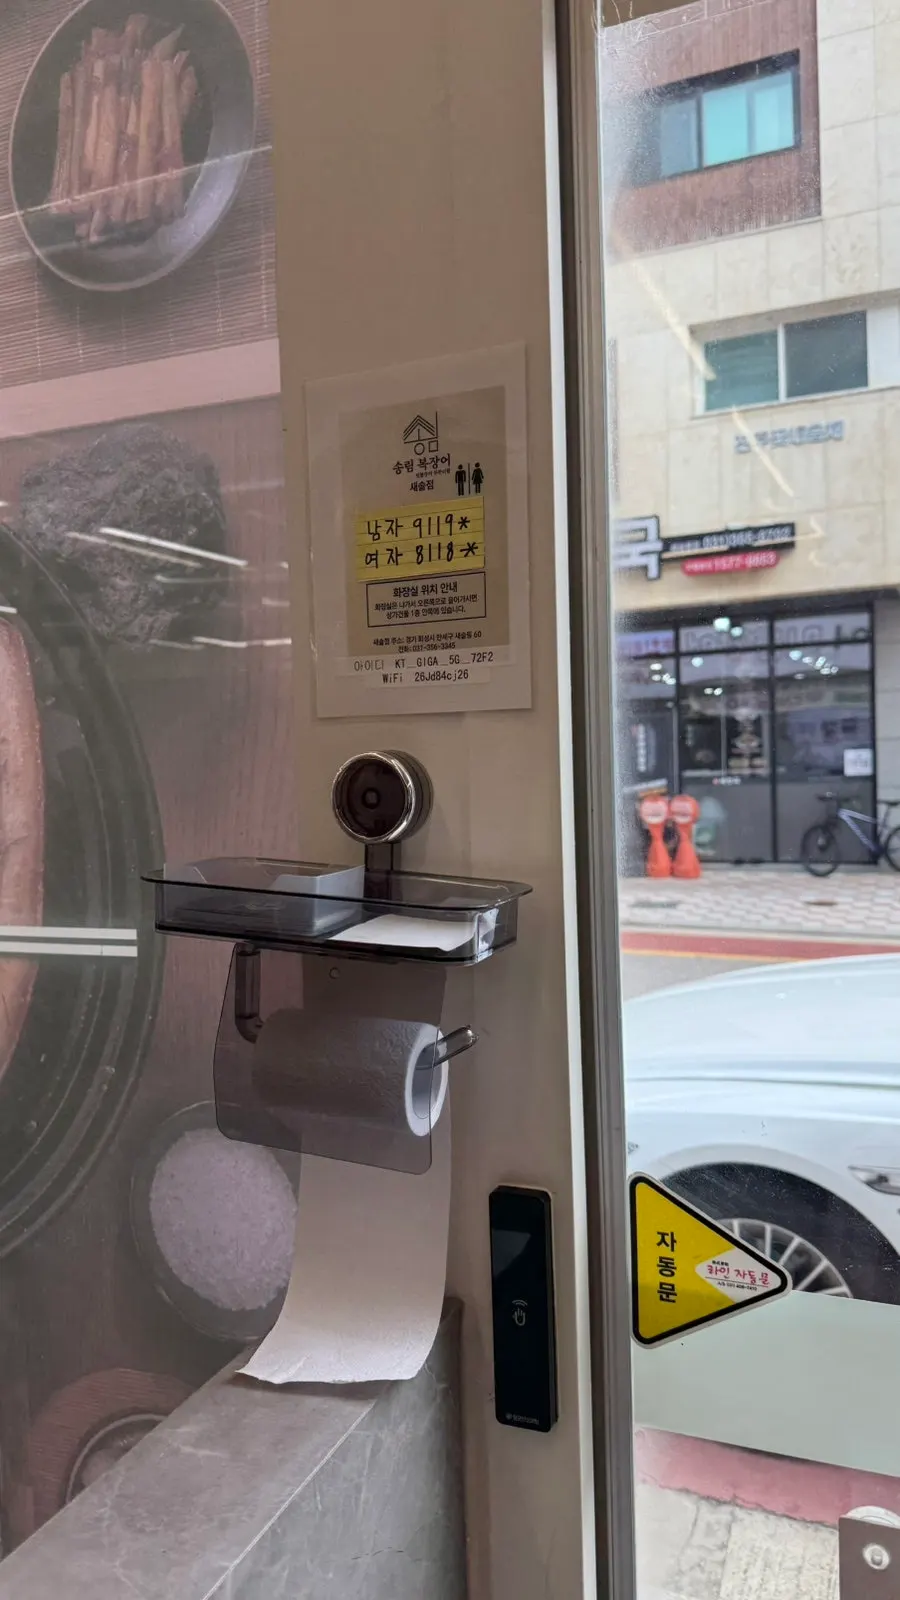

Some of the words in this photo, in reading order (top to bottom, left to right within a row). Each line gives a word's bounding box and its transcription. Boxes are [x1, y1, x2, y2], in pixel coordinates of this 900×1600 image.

[392, 459, 414, 475] 송림
[417, 453, 451, 471] 복장어
[409, 479, 434, 492] 새솔점
[367, 518, 403, 542] 남자
[365, 546, 403, 569] 여자
[392, 586, 419, 598] 화장실
[420, 583, 438, 595] 위치
[440, 581, 458, 594] 안내
[374, 602, 399, 612] 화장실은
[417, 597, 447, 607] 오른쪽으로
[447, 594, 478, 605] 들어가시면
[386, 610, 409, 620] 상가건물
[411, 609, 420, 618] 1층
[422, 607, 440, 617] 안쪽에
[440, 604, 466, 615] 있습니다.
[406, 635, 417, 644] 경기
[418, 633, 435, 643] 화성시
[473, 630, 482, 638] 60
[353, 659, 385, 672] 아이디
[382, 672, 403, 684] WiFi
[706, 1264, 731, 1279] 라인
